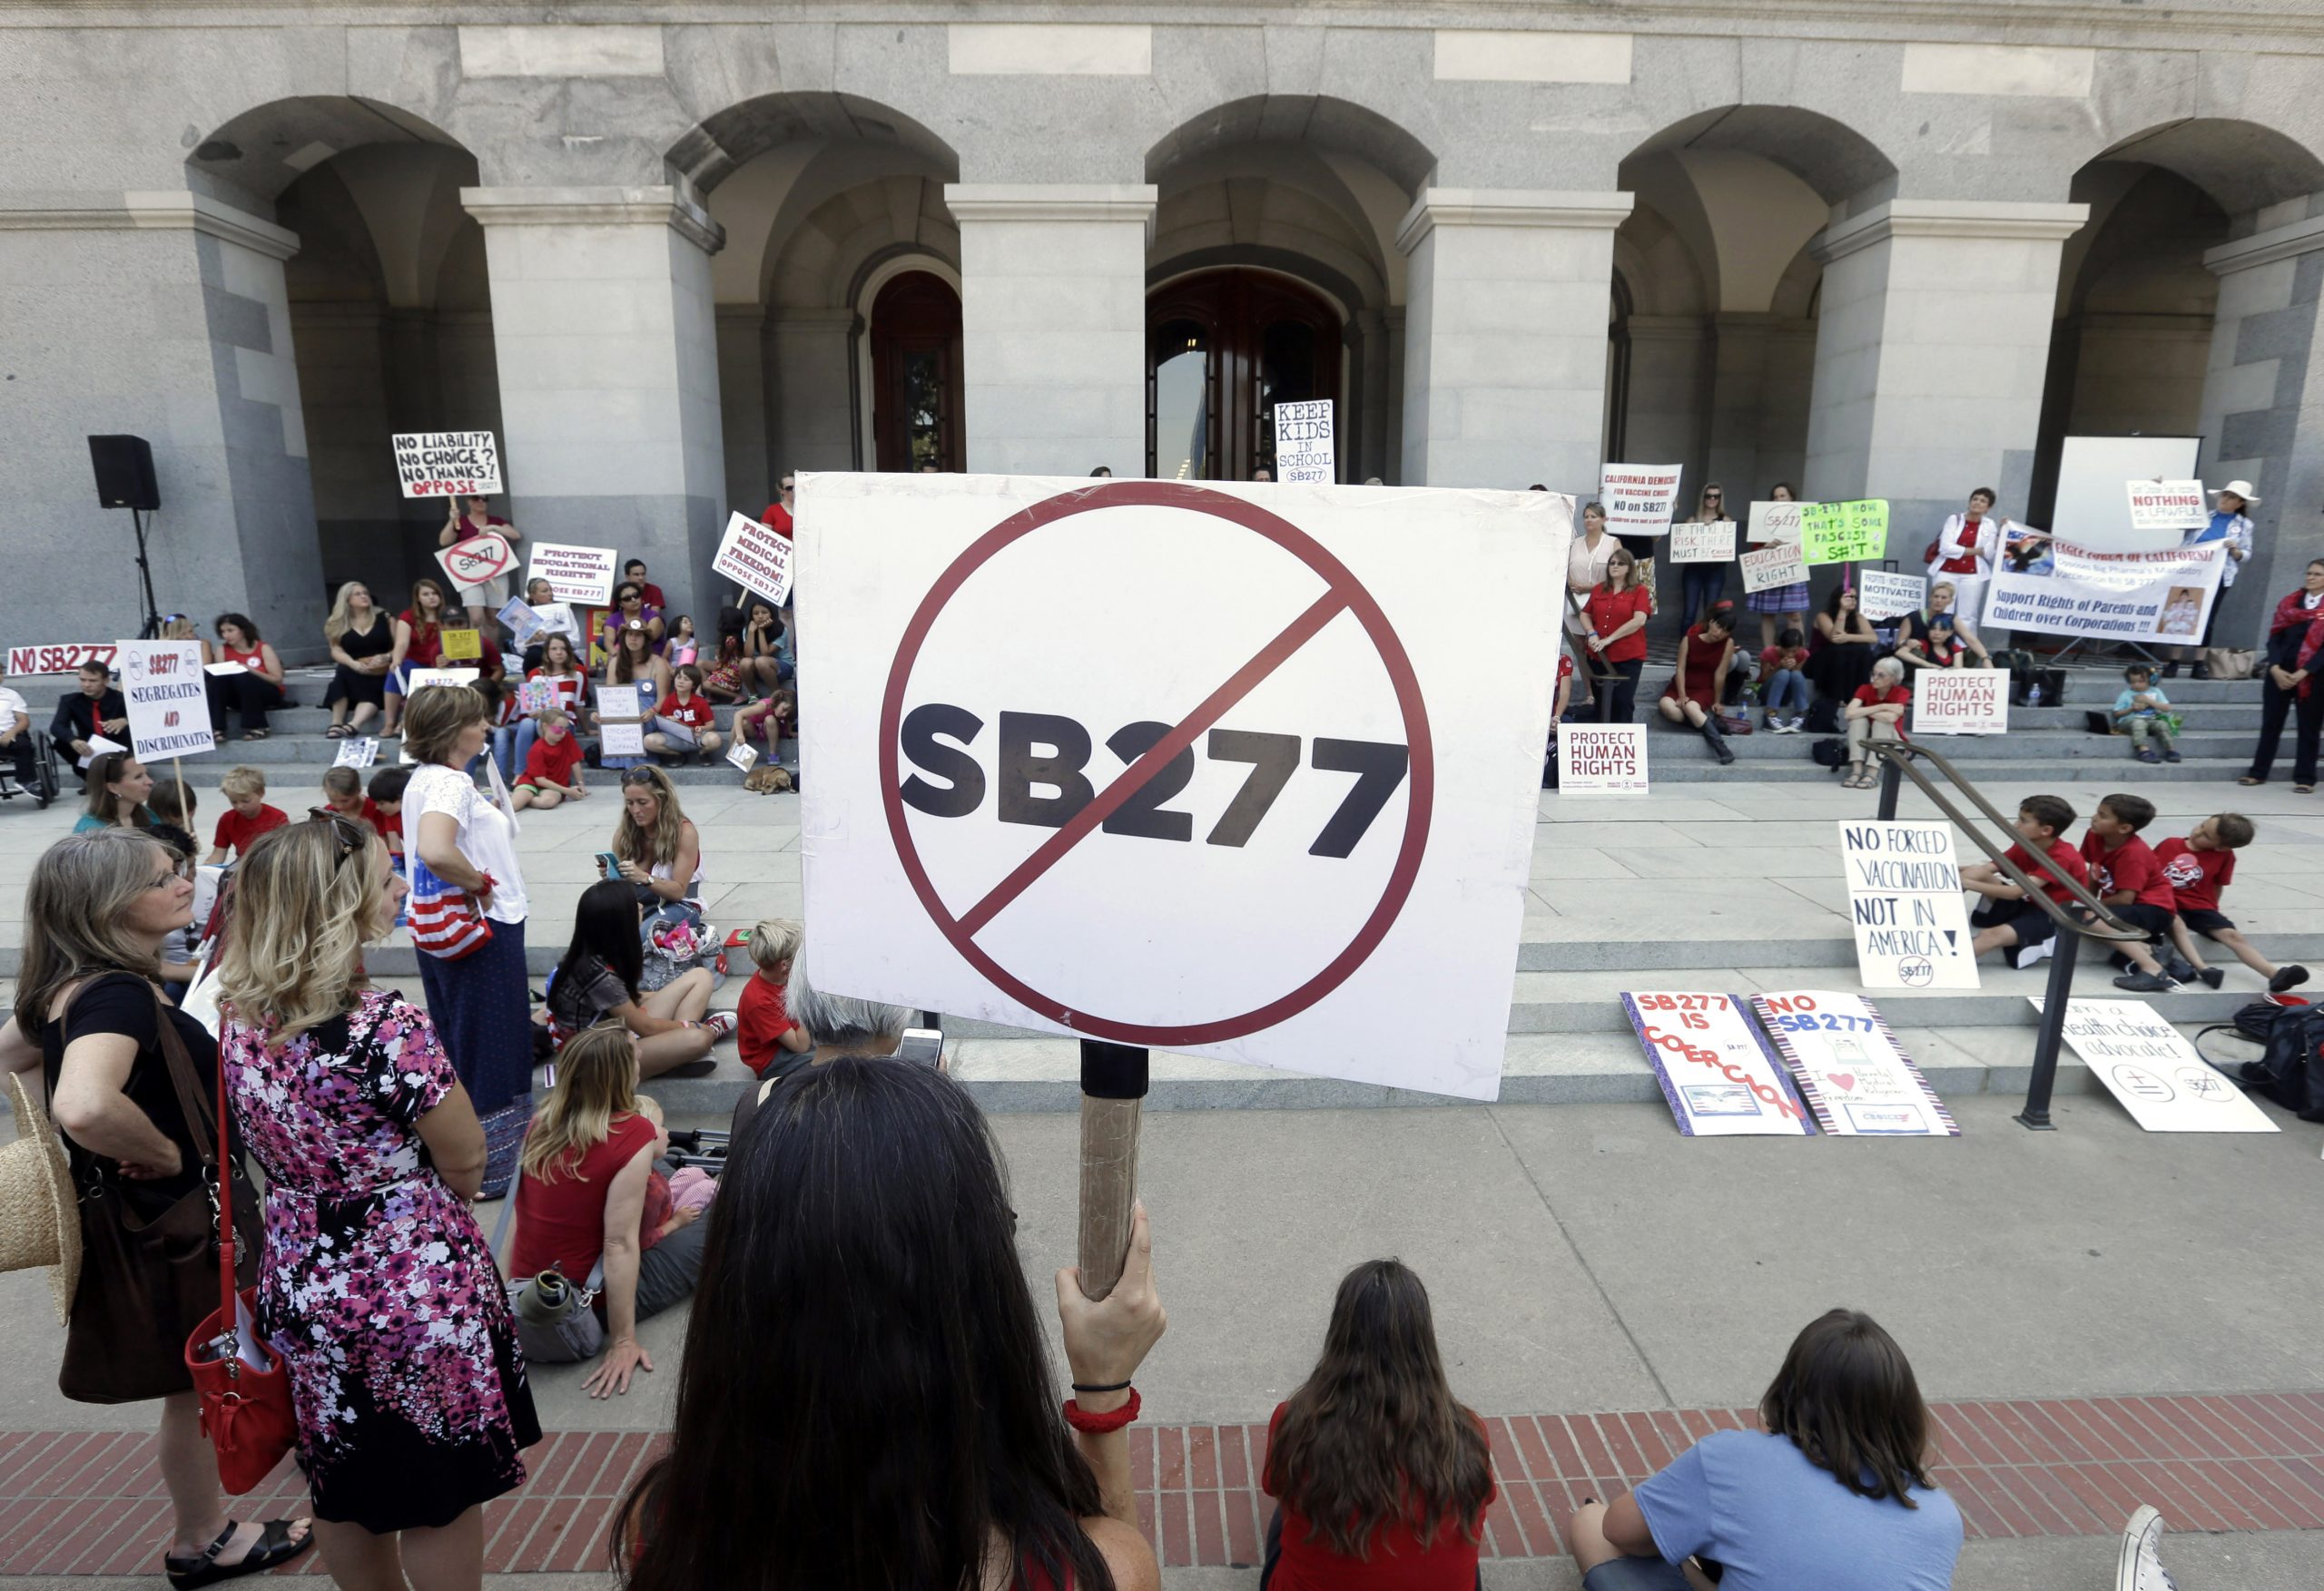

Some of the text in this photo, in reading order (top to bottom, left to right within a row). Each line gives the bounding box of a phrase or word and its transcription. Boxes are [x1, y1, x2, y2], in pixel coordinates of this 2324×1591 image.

[1278, 402, 1330, 421] KEEP
[1278, 420, 1331, 441] KIDS
[396, 436, 417, 450] NO
[1297, 441, 1313, 453] IN
[399, 453, 419, 466] NO
[1279, 453, 1332, 466] SCHOOL
[401, 469, 425, 483] NO
[1290, 470, 1323, 481] SB277
[1604, 475, 1646, 486] CALIFORNIA
[412, 480, 477, 496] OPPOSE
[1614, 501, 1667, 513] NO on SB277
[1852, 503, 1876, 513] NOW
[2132, 496, 2200, 506] NOTHING
[2149, 506, 2203, 516] LAWFUL
[1674, 525, 1684, 535] IF
[1723, 523, 1733, 534] IS
[1807, 517, 1882, 530] THAT'S SOME
[742, 522, 792, 555] PROTECT
[1701, 535, 1733, 546] THERE
[1815, 531, 1866, 543] FASCIST
[543, 549, 602, 561] PROTECT
[736, 535, 784, 569] MEDICAL
[1672, 548, 1698, 559] MUST
[1744, 545, 1801, 567] EDUCATION
[2055, 542, 2084, 558] EAGLE
[2127, 553, 2142, 563] OF
[533, 558, 610, 571] EDUCATIONAL
[728, 545, 783, 584] FREEDOM!
[721, 559, 781, 596] OPPOSE SB277
[1756, 565, 1797, 584] RIGHT
[1864, 584, 1922, 599] MOTIVATES
[1865, 596, 1889, 606] VACCINE
[1996, 589, 2158, 617] Support Rights of Parents and
[1993, 606, 2034, 623] Children
[2035, 614, 2063, 626] over
[2065, 614, 2134, 633] Corporations
[11, 645, 118, 674] NO SB277
[149, 653, 179, 675] SB277
[1927, 677, 1996, 688] PROTECT
[132, 683, 202, 702] SEGREGATES
[1926, 689, 1995, 702] HUMAN
[1926, 702, 1994, 716] RIGHTS
[163, 712, 180, 727] AND
[136, 732, 212, 754] DISCRIMINATES
[1571, 732, 1635, 744] PROTECT
[1571, 745, 1635, 760] HUMAN
[1571, 761, 1636, 775] RIGHTS
[901, 702, 1410, 859] SB277
[1846, 827, 1947, 854] NO FORCED
[1856, 859, 1959, 890] VACCINATION
[1854, 898, 1936, 927] NOT IN
[1638, 994, 1728, 1011] SB277
[1766, 995, 1817, 1014] NO
[2110, 1007, 2128, 1016] a
[1679, 1012, 1710, 1029] IS
[1777, 1013, 1875, 1033] SB277
[2063, 1018, 2178, 1039] health choice
[2084, 1039, 2181, 1059] advocate!
[1642, 1026, 1806, 1120] COERCION
